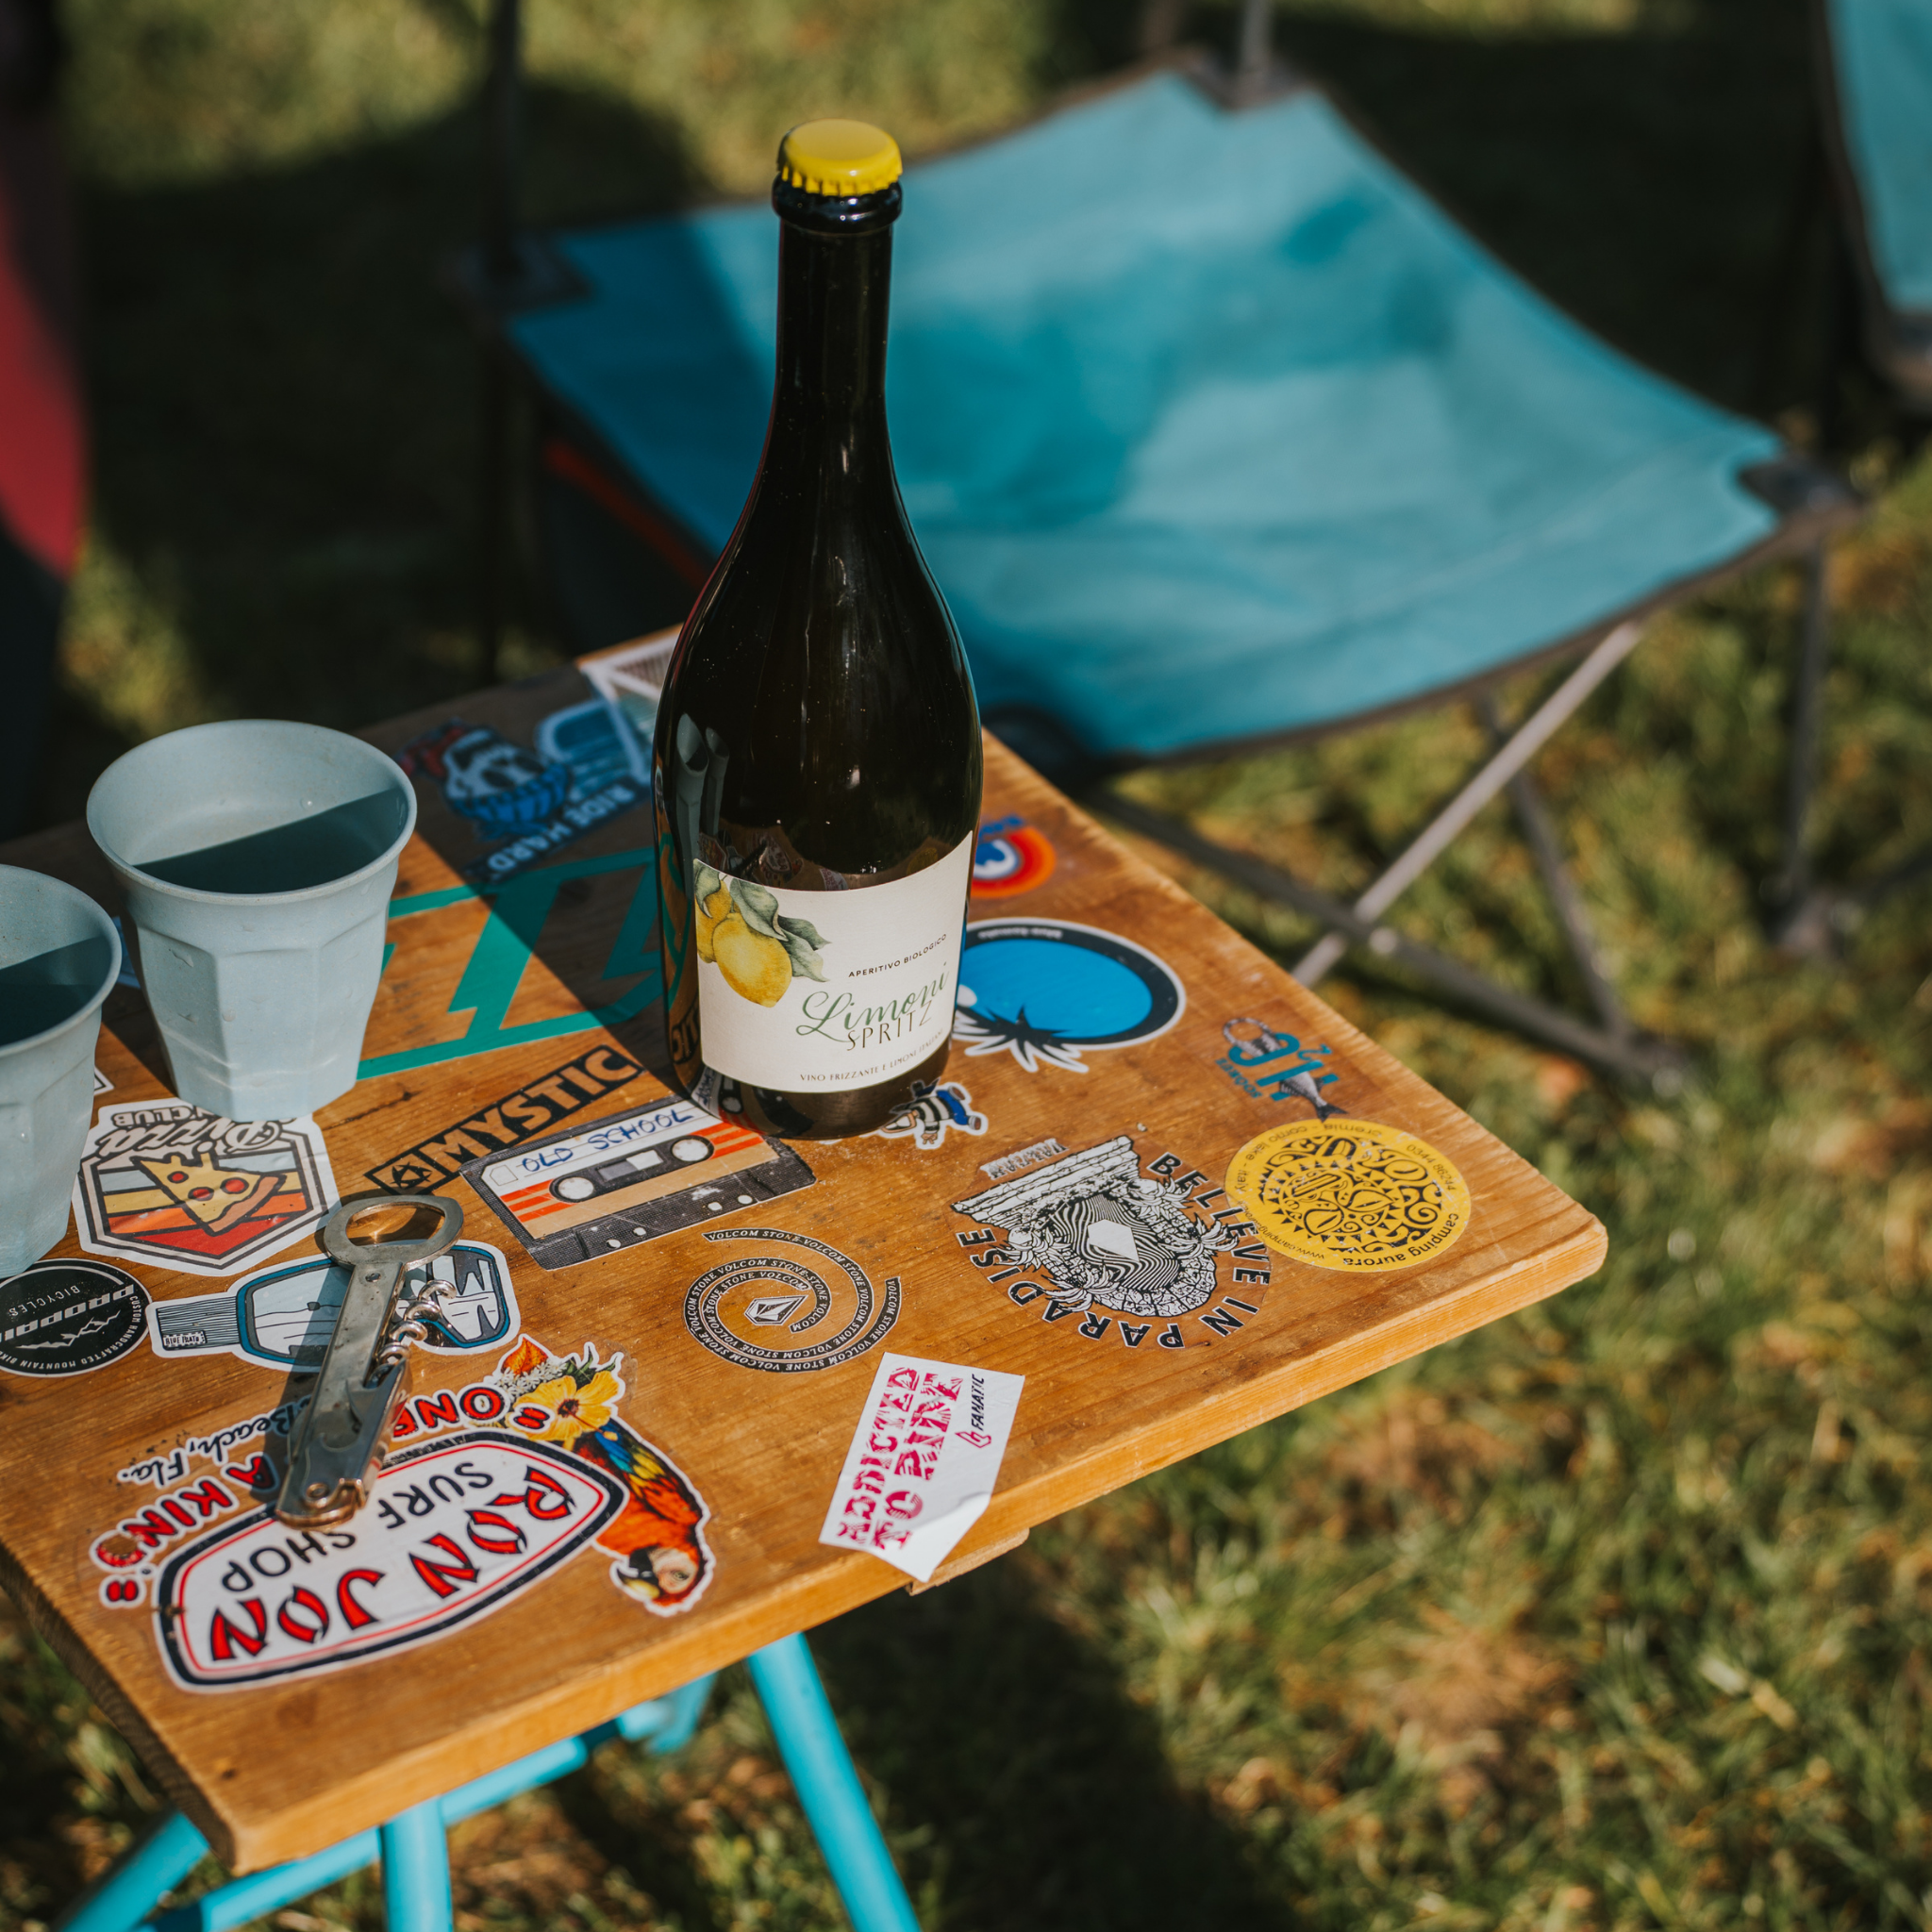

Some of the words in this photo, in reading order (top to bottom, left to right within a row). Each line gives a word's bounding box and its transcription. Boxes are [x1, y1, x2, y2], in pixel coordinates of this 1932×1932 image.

[487, 823, 572, 871] HARD
[848, 959, 901, 977] APERITIVO
[903, 933, 947, 963] BIOLOGICO
[795, 961, 950, 1042] Limoni
[846, 1000, 932, 1051] SPRITZ
[800, 1074, 825, 1082] VINO
[830, 1066, 878, 1080] FRIZZANTE
[890, 1049, 917, 1068] LIMONI
[418, 1048, 639, 1174] MYSTIC
[97, 1117, 282, 1157] Pizza
[522, 1147, 574, 1172] OLD
[588, 1108, 693, 1150] SCHOOL
[1269, 1125, 1308, 1142] como
[1245, 1143, 1267, 1161] lake
[1406, 1143, 1436, 1164] 0344
[1432, 1161, 1457, 1191] 86244
[709, 1229, 758, 1241] VOLCOM
[1146, 1151, 1271, 1286] BELIEVE
[1408, 1213, 1459, 1257] camping
[718, 1259, 767, 1274] VOLCOM
[804, 1239, 845, 1262] VOLCOM
[1342, 1253, 1407, 1268] aurora
[691, 1273, 717, 1297] STONE
[721, 1273, 755, 1289] STONE
[759, 1271, 807, 1290] VOLCOM
[808, 1275, 828, 1301] STONE
[842, 1262, 866, 1287] STONE
[956, 1227, 1185, 1349] PARADISE
[9, 1285, 80, 1317] BICYCLES
[129, 1295, 142, 1323] CUSTOM
[687, 1297, 702, 1331] VOLCOM
[707, 1289, 720, 1314] STONE
[856, 1289, 869, 1323] VOLCOM
[887, 1281, 898, 1315] VOLCOM
[707, 1315, 740, 1346] VOLCOM
[792, 1303, 827, 1332] VOLCOM
[833, 1322, 859, 1345] STONE
[870, 1315, 892, 1341] STONE
[1198, 1296, 1259, 1338] IN
[81, 1324, 139, 1365] HANDCRAFTED
[699, 1332, 729, 1355] STONE
[740, 1344, 779, 1358] STONE
[783, 1343, 832, 1358] VOLCOM
[828, 1340, 872, 1365] VOLCOM
[20, 1360, 75, 1370] MOUNTAIN
[729, 1354, 780, 1371] VOLCOM
[786, 1359, 824, 1371] STONE
[971, 1374, 985, 1432] FANATIC
[190, 1403, 295, 1462] Beach,
[893, 1373, 964, 1482] RIDE
[121, 1451, 185, 1487] Fla.
[836, 1367, 921, 1545] ADDICTED
[225, 1456, 277, 1491] A
[377, 1462, 494, 1529] SURF
[408, 1465, 576, 1599] RON
[871, 1491, 924, 1551] TO
[210, 1568, 387, 1662] JON
